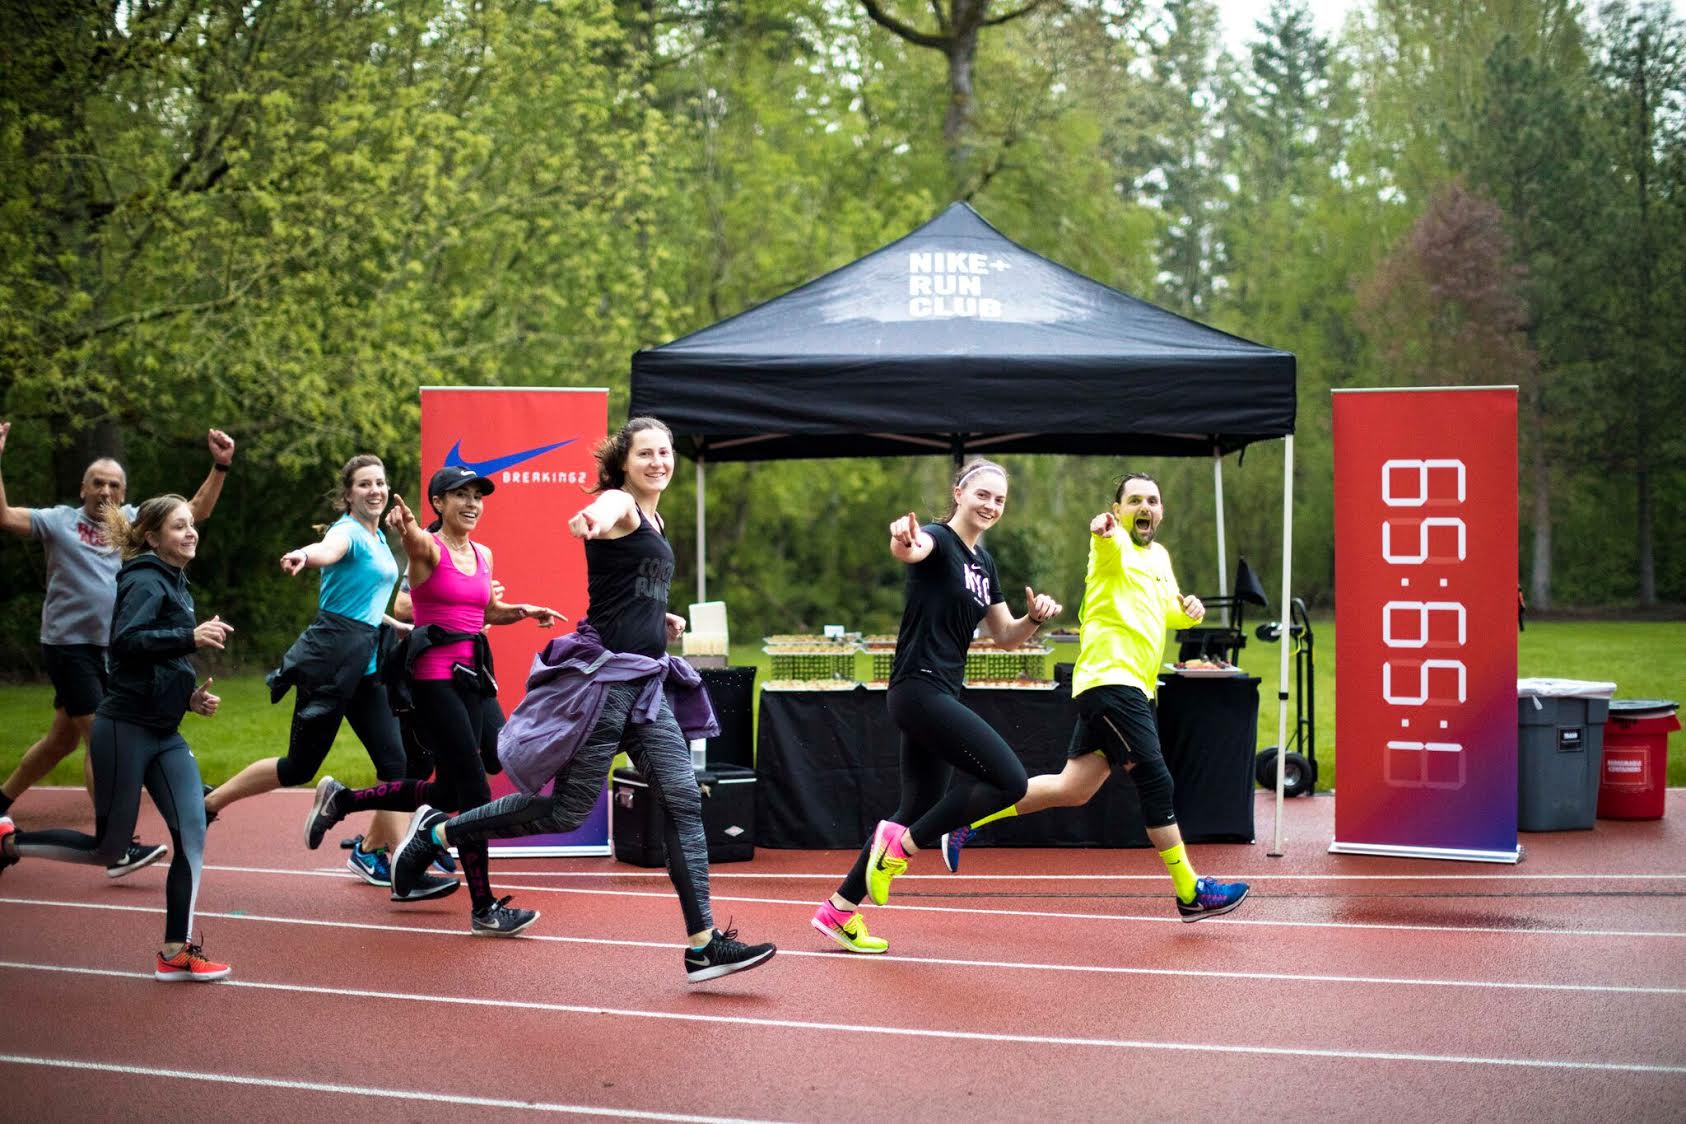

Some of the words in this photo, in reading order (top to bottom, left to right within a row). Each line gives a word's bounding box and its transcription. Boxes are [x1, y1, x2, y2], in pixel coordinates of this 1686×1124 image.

[909, 251, 1012, 275] NIKE+
[909, 274, 981, 296] RUN
[909, 296, 1003, 318] CLUB
[1381, 458, 1467, 752] 1:59:59
